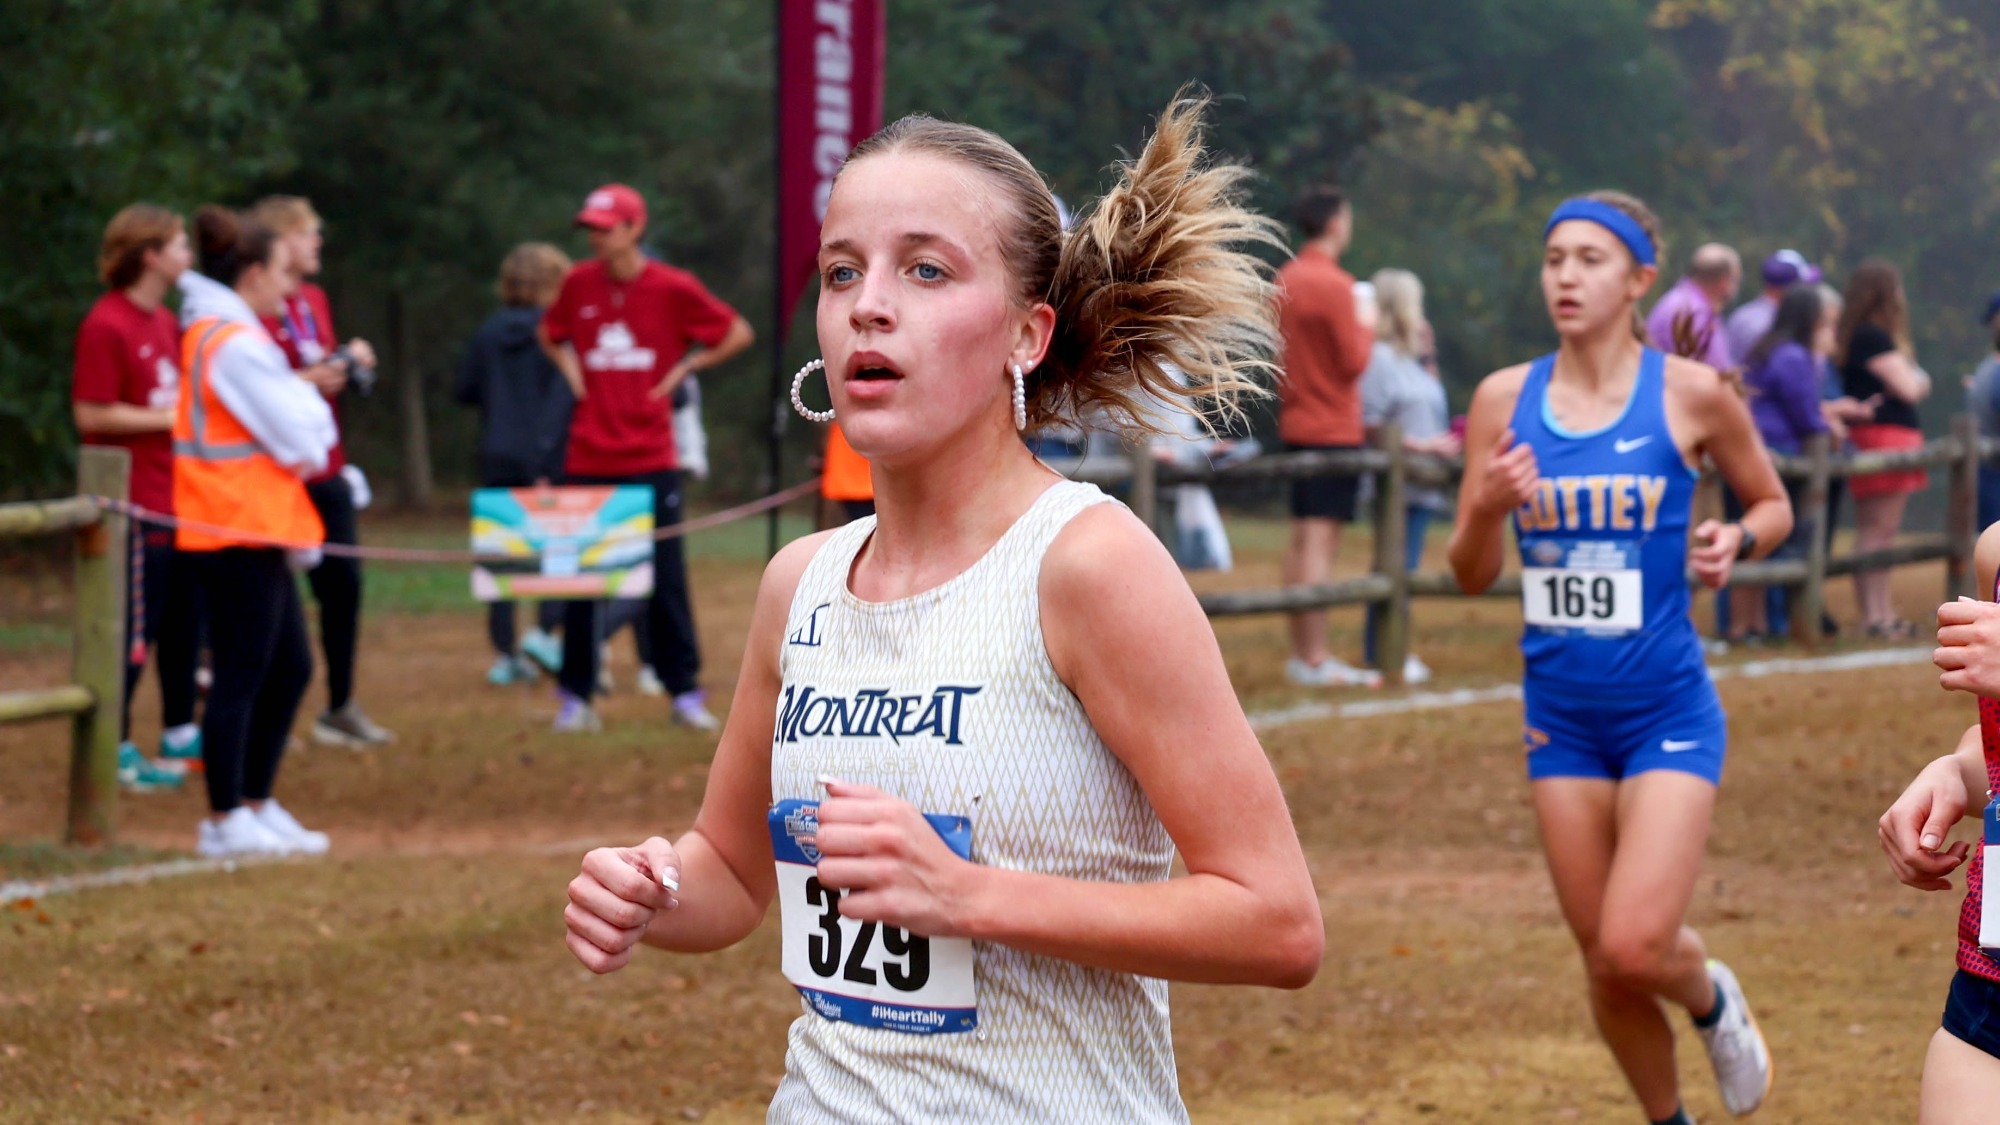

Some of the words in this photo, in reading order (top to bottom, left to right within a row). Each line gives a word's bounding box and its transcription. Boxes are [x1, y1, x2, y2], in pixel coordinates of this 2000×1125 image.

[1543, 575, 1616, 620] 169
[775, 683, 983, 747] MONTREAT
[806, 876, 930, 992] 329
[871, 1005, 946, 1027] #iHeartTally
